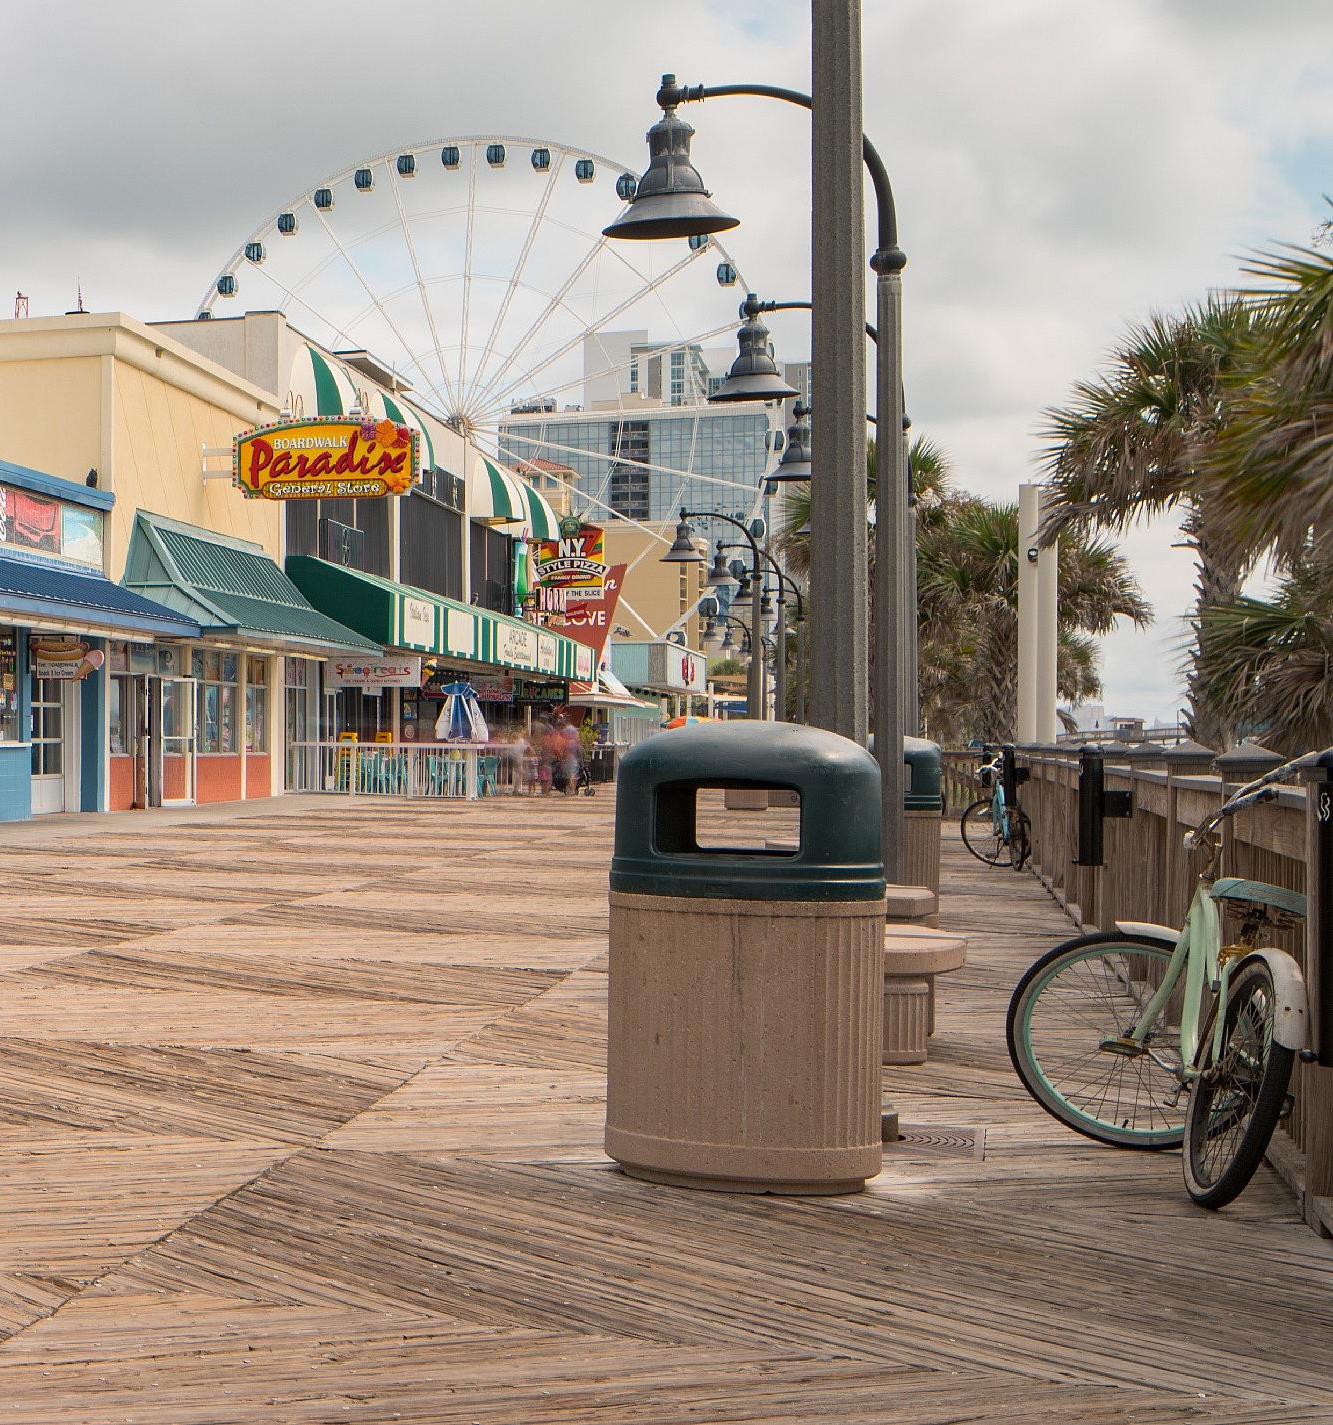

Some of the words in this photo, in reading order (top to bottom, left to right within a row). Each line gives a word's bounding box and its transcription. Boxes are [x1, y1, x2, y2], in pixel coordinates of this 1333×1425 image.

[273, 435, 348, 450] BOARDWALK
[249, 429, 407, 489] Paradise
[269, 482, 332, 497] General
[337, 482, 381, 496] Store
[558, 537, 586, 558] N.Y.
[537, 560, 571, 575] STYLE
[574, 560, 605, 574] PIZZA
[584, 589, 601, 597] SLICE
